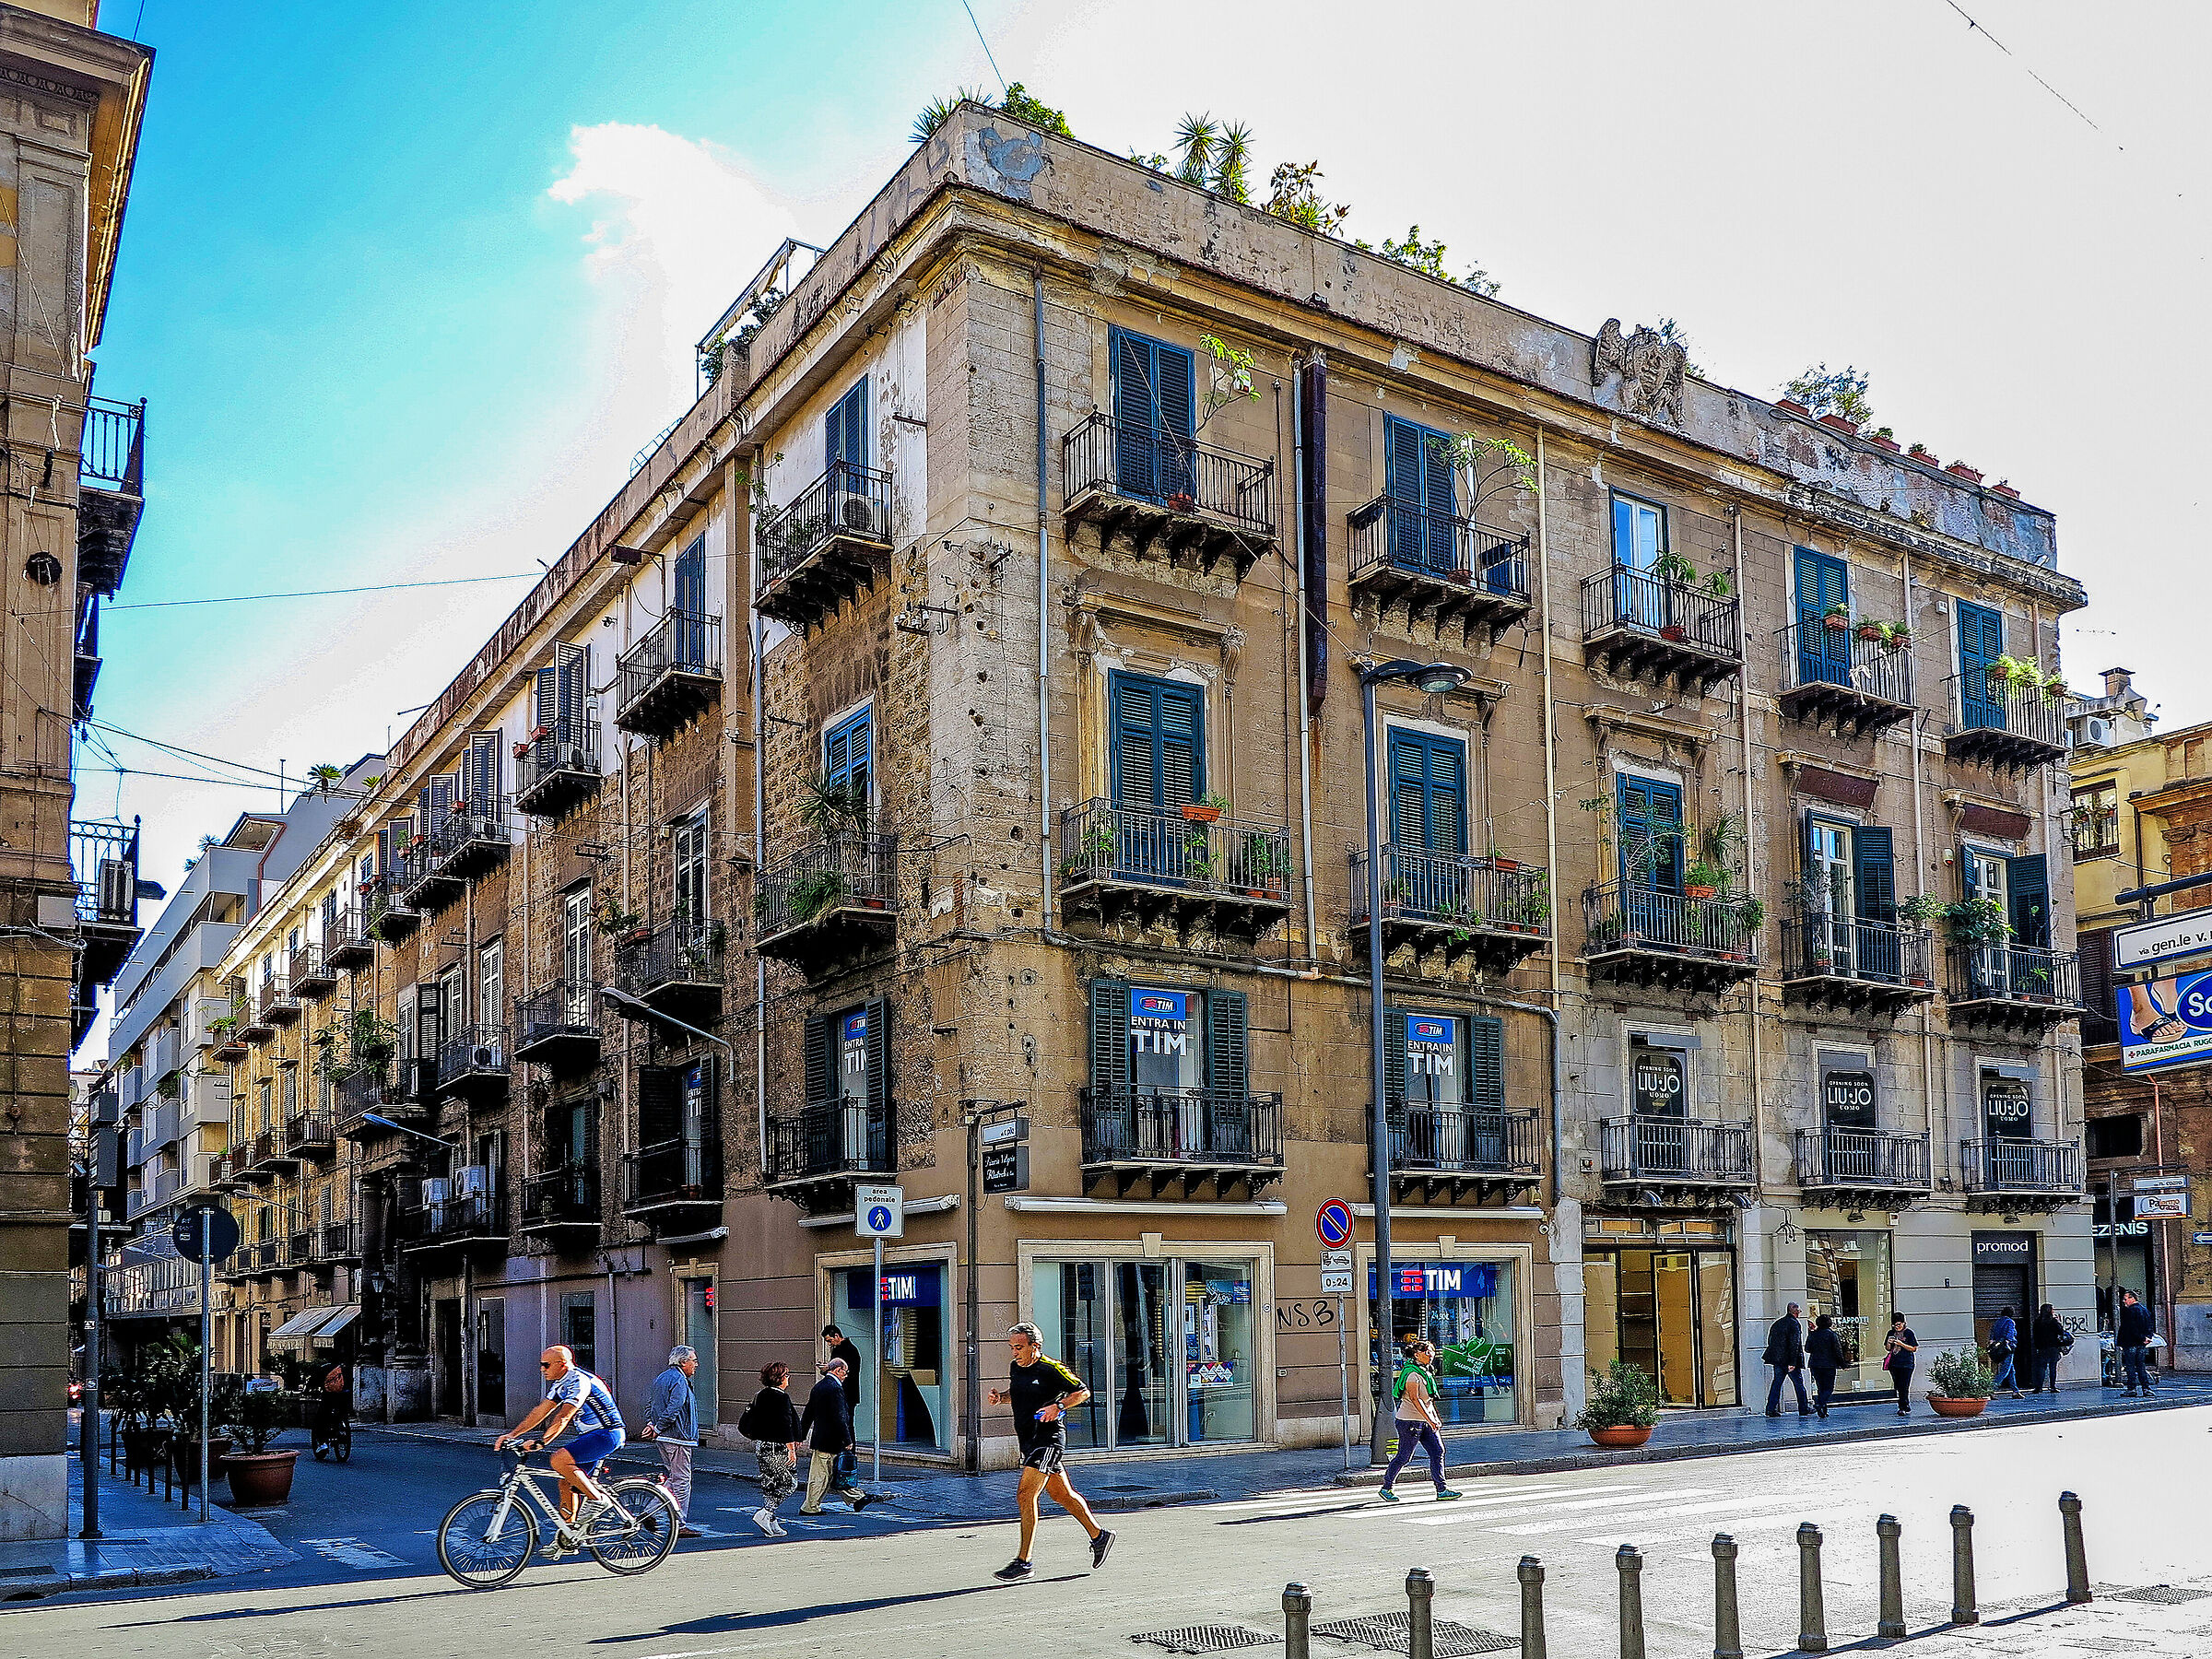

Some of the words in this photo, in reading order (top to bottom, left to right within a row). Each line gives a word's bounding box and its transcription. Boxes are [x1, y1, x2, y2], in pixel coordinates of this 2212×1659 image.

[2138, 947, 2150, 956] via
[2151, 934, 2192, 955] gen.le
[2195, 932, 2207, 943] v.
[1157, 1001, 1174, 1010] TIM
[1131, 1017, 1170, 1029] ENTRA
[1173, 1019, 1186, 1030] IN
[1429, 1026, 1442, 1035] TIM
[844, 1036, 865, 1051] ENTRA
[1130, 1029, 1187, 1056] TIM
[1407, 1040, 1440, 1052] ENTRA
[1442, 1042, 1453, 1053] IN
[2136, 1041, 2192, 1057] PARAFARMACIA
[1407, 1052, 1453, 1077] TIM
[1976, 1240, 2029, 1255] promod
[1425, 1268, 1462, 1291] TIM
[888, 1276, 916, 1300] TIM
